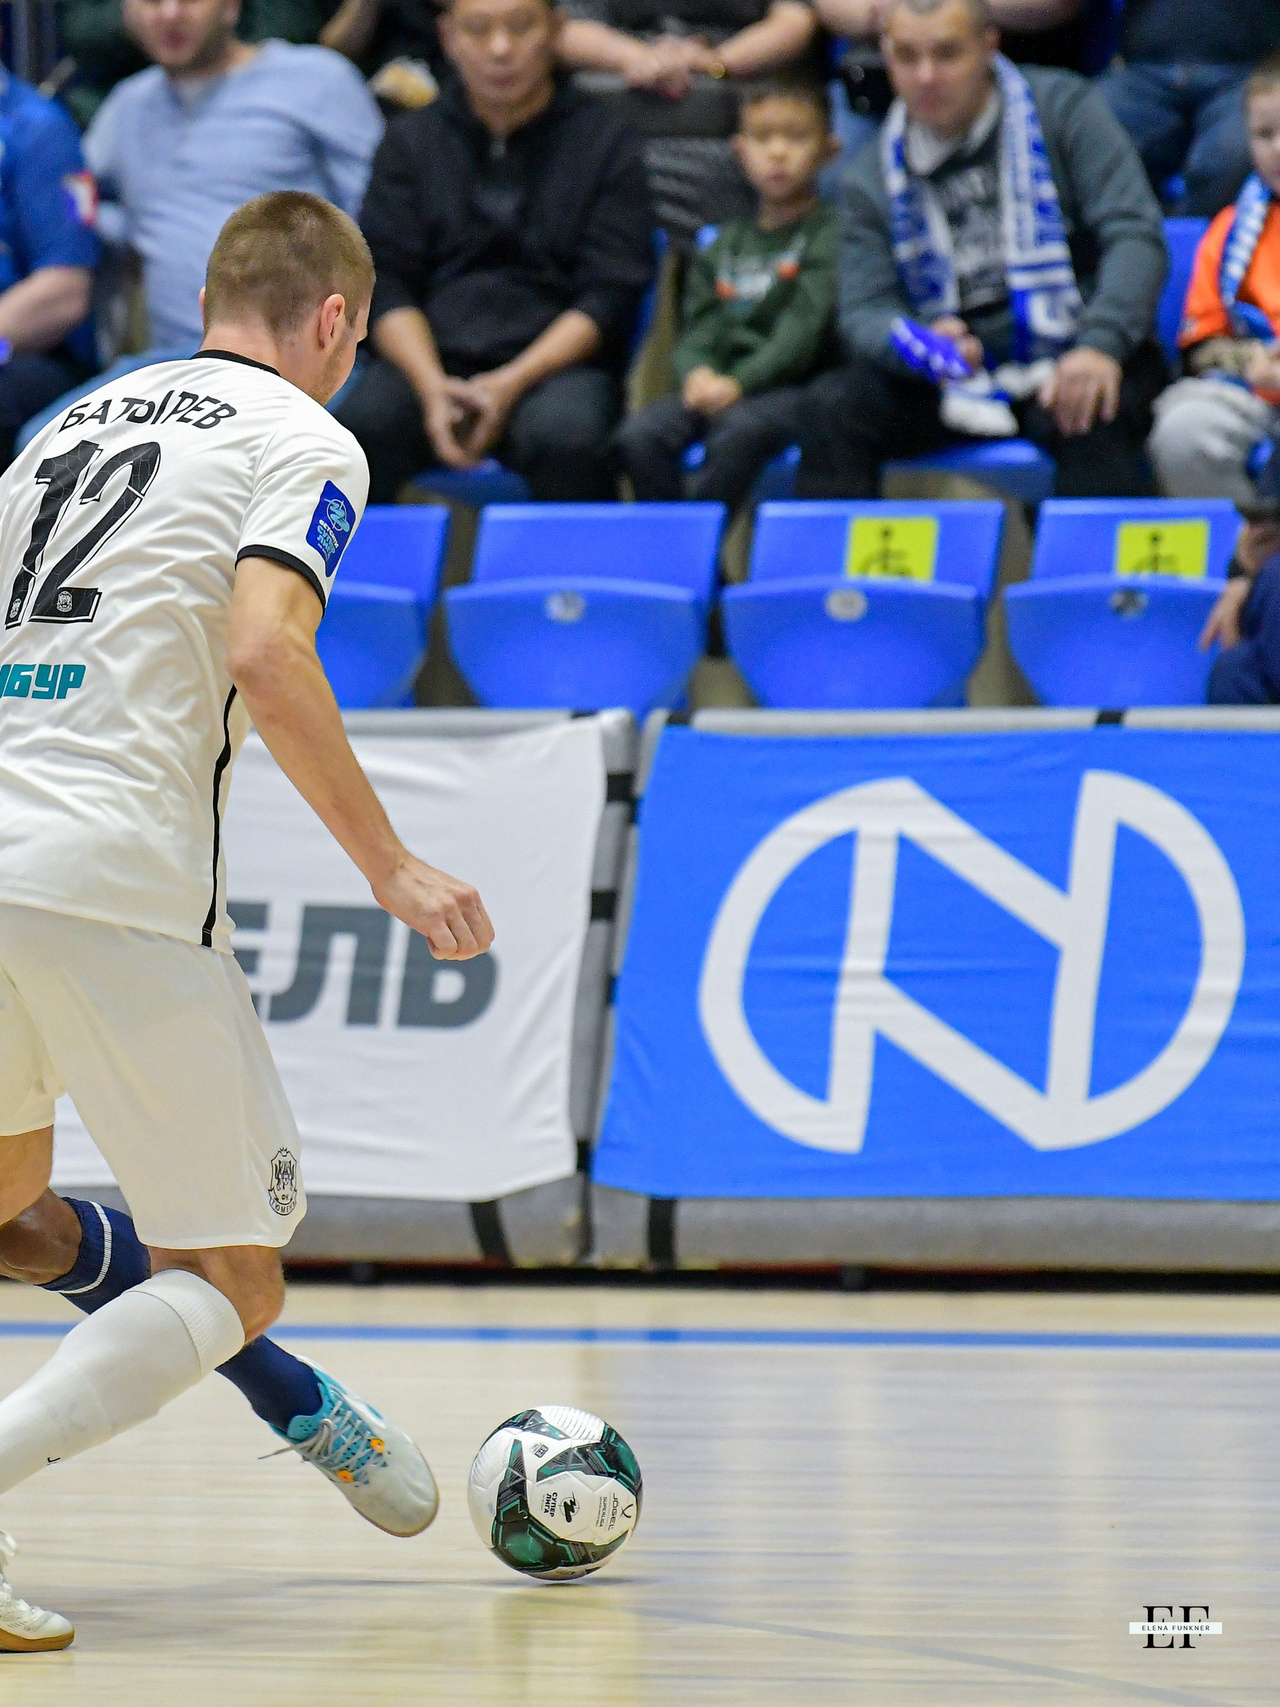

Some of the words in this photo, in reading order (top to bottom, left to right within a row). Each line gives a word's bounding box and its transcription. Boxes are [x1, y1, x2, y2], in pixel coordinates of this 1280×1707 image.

[58, 389, 238, 434] БАТЫРЕВ
[4, 439, 162, 630] 12
[550, 1492, 558, 1517] СУПЕР
